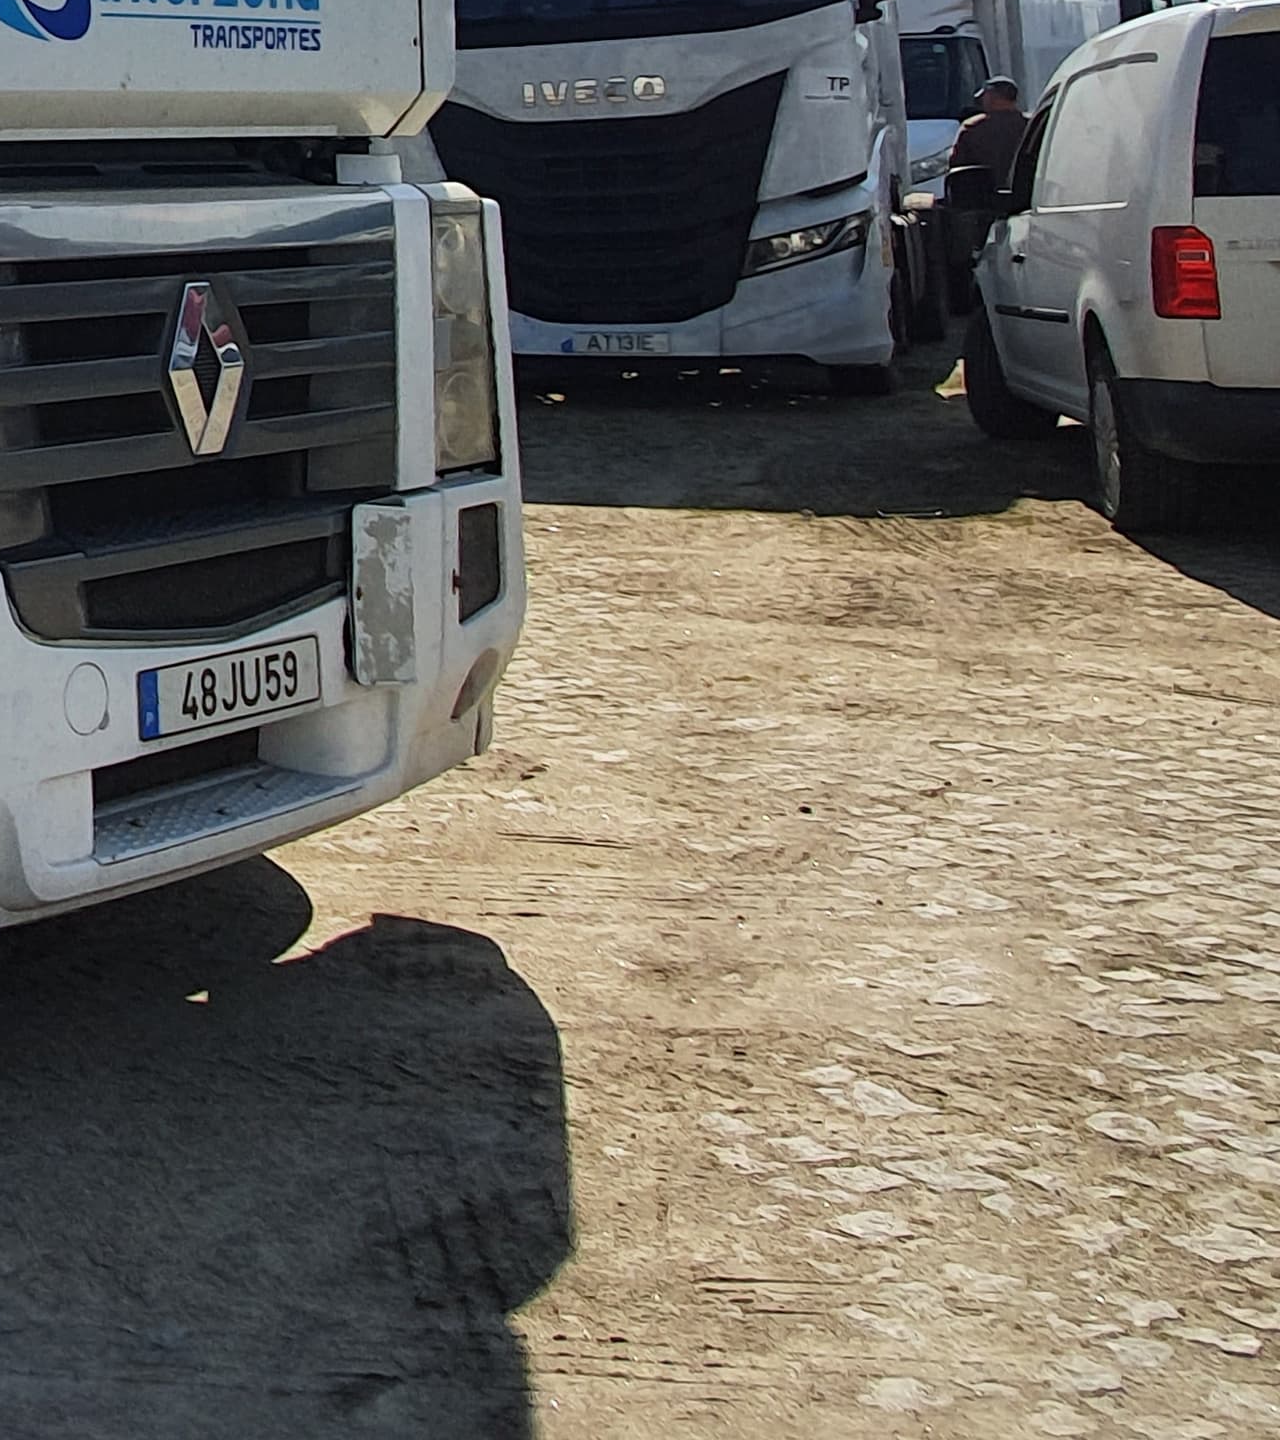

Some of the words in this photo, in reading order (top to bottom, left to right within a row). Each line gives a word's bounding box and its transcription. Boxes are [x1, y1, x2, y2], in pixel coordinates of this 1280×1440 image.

[190, 23, 321, 52] TRANSPORTES
[522, 75, 665, 107] IVECO
[826, 76, 850, 91] TP
